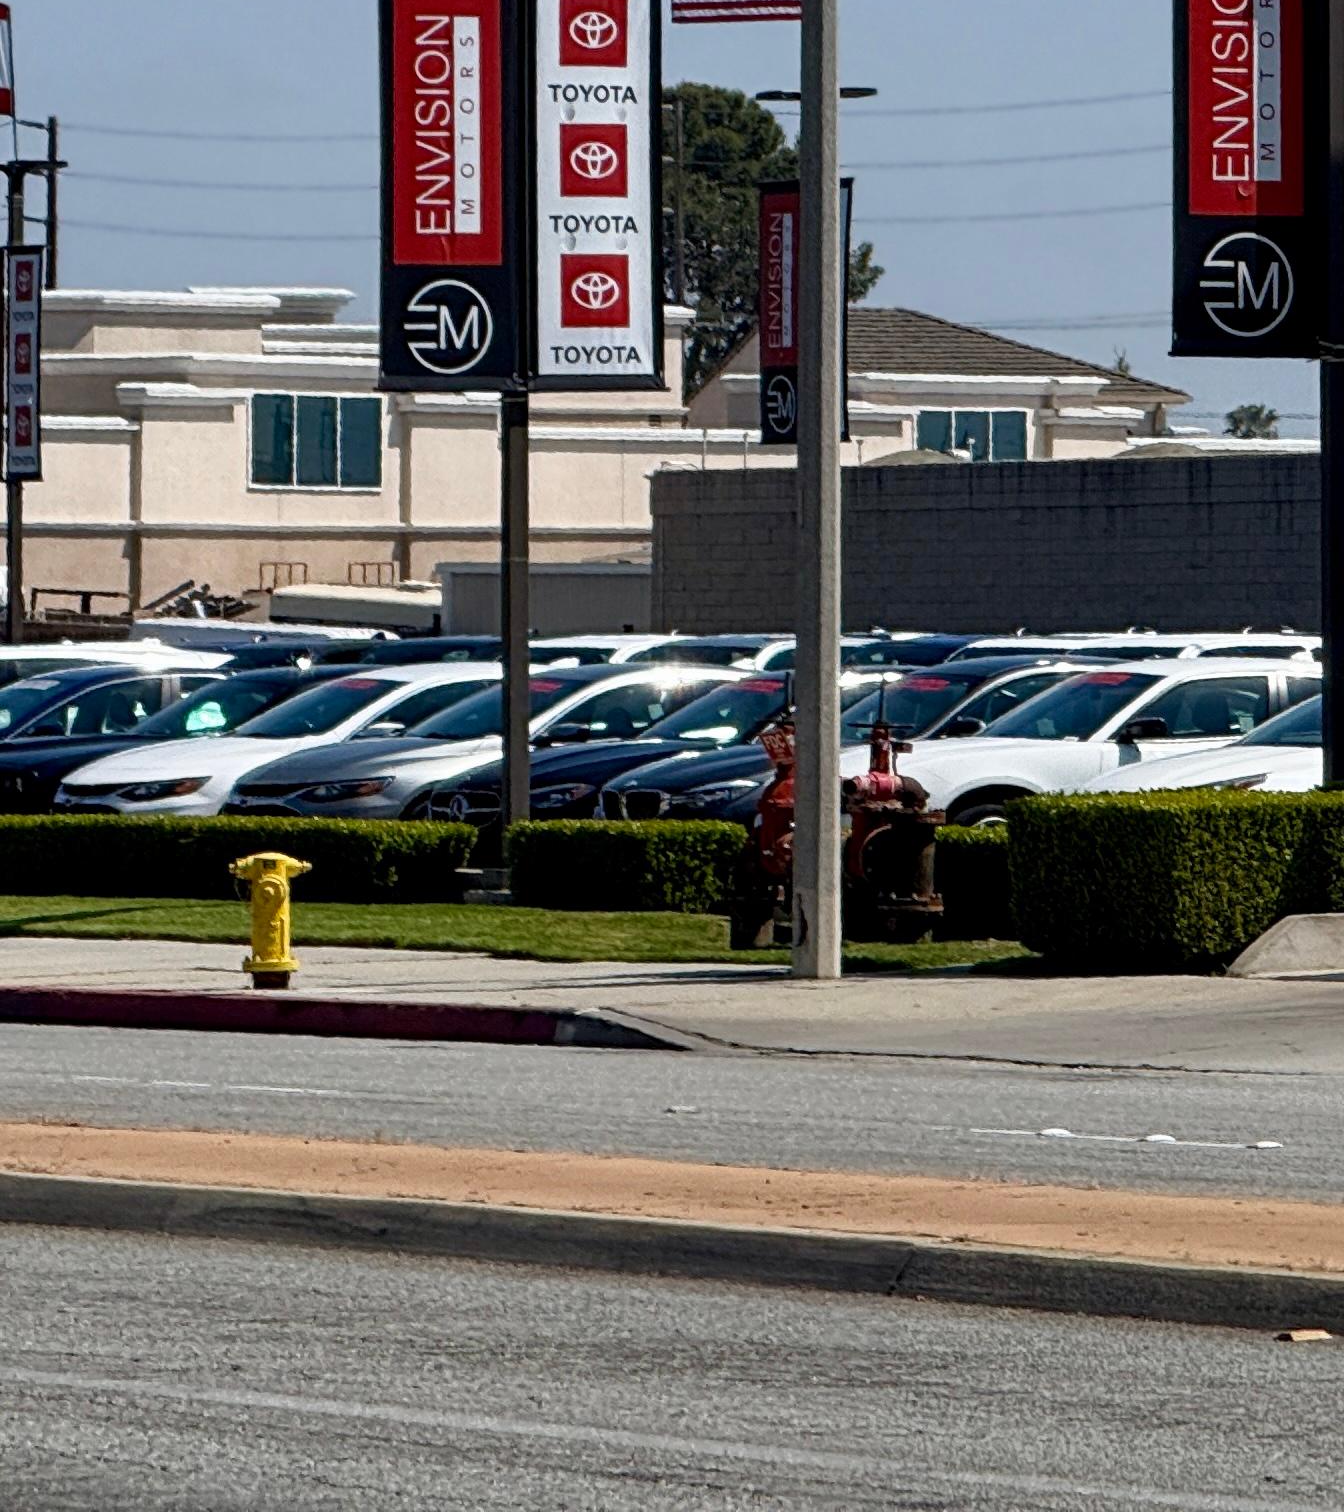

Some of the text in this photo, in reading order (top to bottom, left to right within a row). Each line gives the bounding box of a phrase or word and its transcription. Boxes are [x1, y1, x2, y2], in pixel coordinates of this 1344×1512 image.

[415, 15, 451, 236] ENVISION
[461, 36, 475, 215] MOTORS
[548, 84, 638, 104] TOYOTA
[549, 215, 639, 235] TOYOTA
[769, 213, 781, 348] ENVISION
[550, 346, 642, 365] TOYOTA
